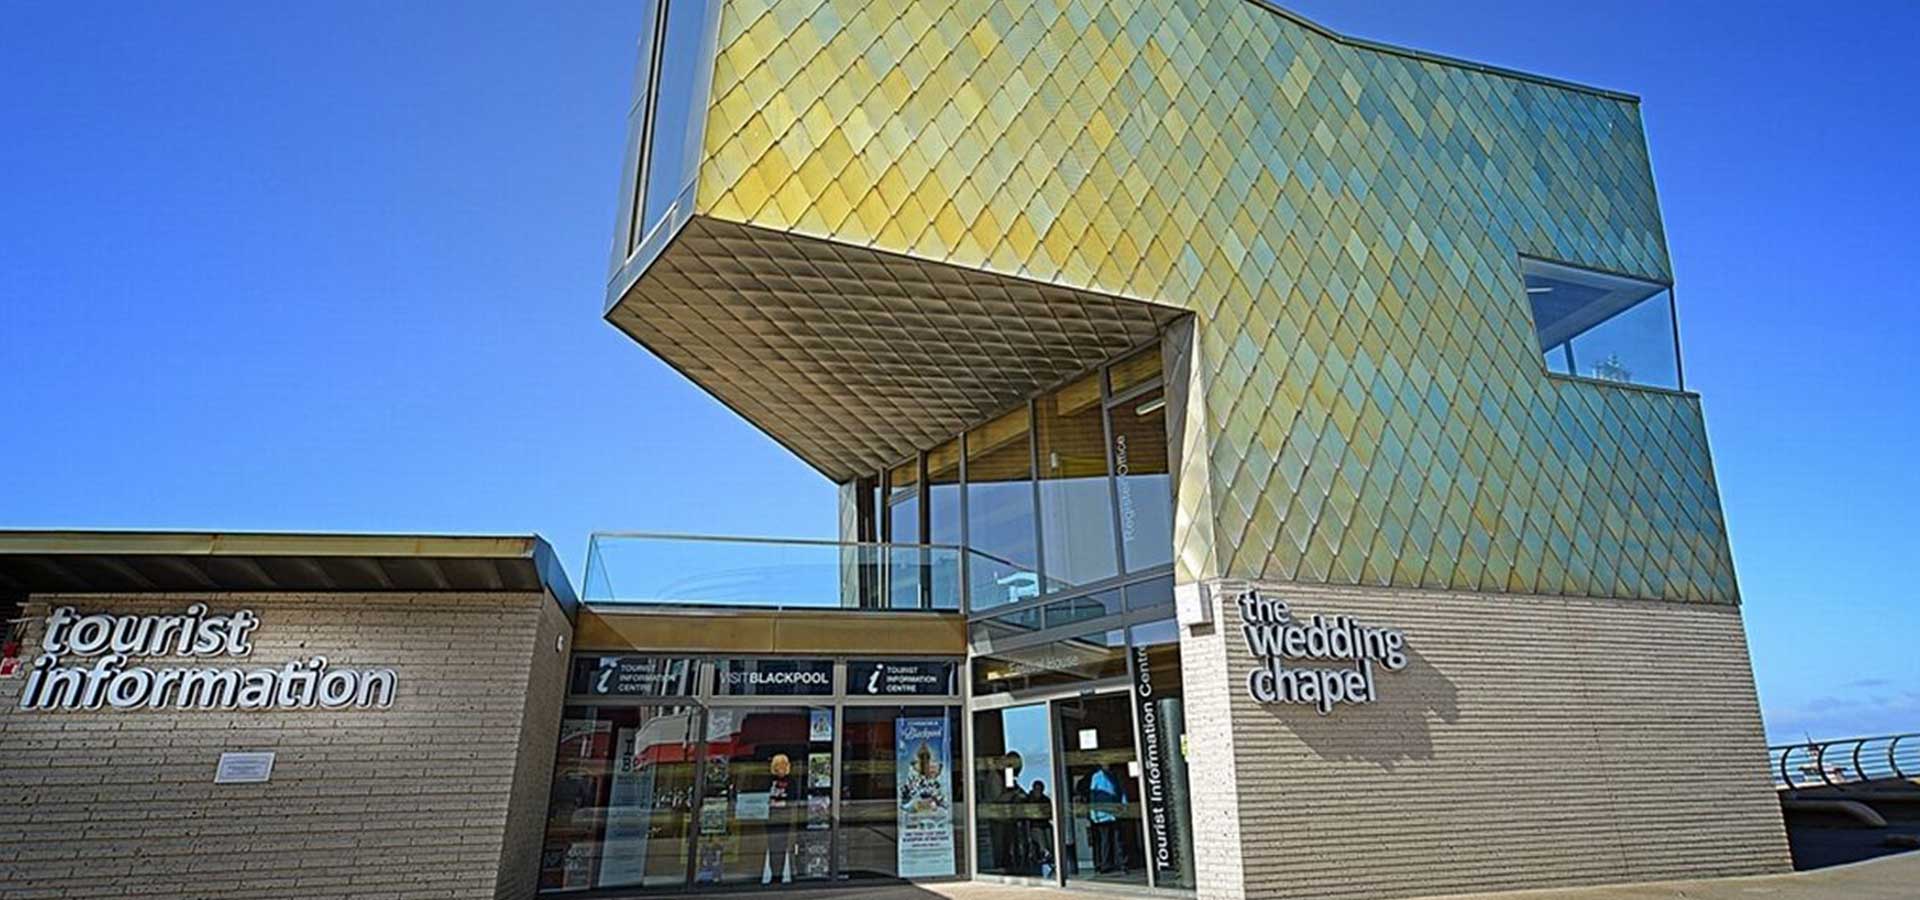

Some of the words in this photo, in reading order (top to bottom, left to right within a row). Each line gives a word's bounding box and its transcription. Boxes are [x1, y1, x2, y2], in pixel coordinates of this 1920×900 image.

[1238, 589, 1290, 624] the
[42, 603, 258, 656] tourist
[1242, 614, 1407, 672] wedding
[20, 656, 398, 711] information
[617, 683, 652, 692] CENTRE
[619, 664, 656, 673] TOURIST
[885, 675, 937, 683] INFORMATION
[885, 684, 917, 692] CENTRE
[886, 666, 918, 674] TOURIST
[1247, 656, 1377, 715] chapel
[1143, 702, 1162, 801] Information
[1152, 807, 1169, 871] Tourist
